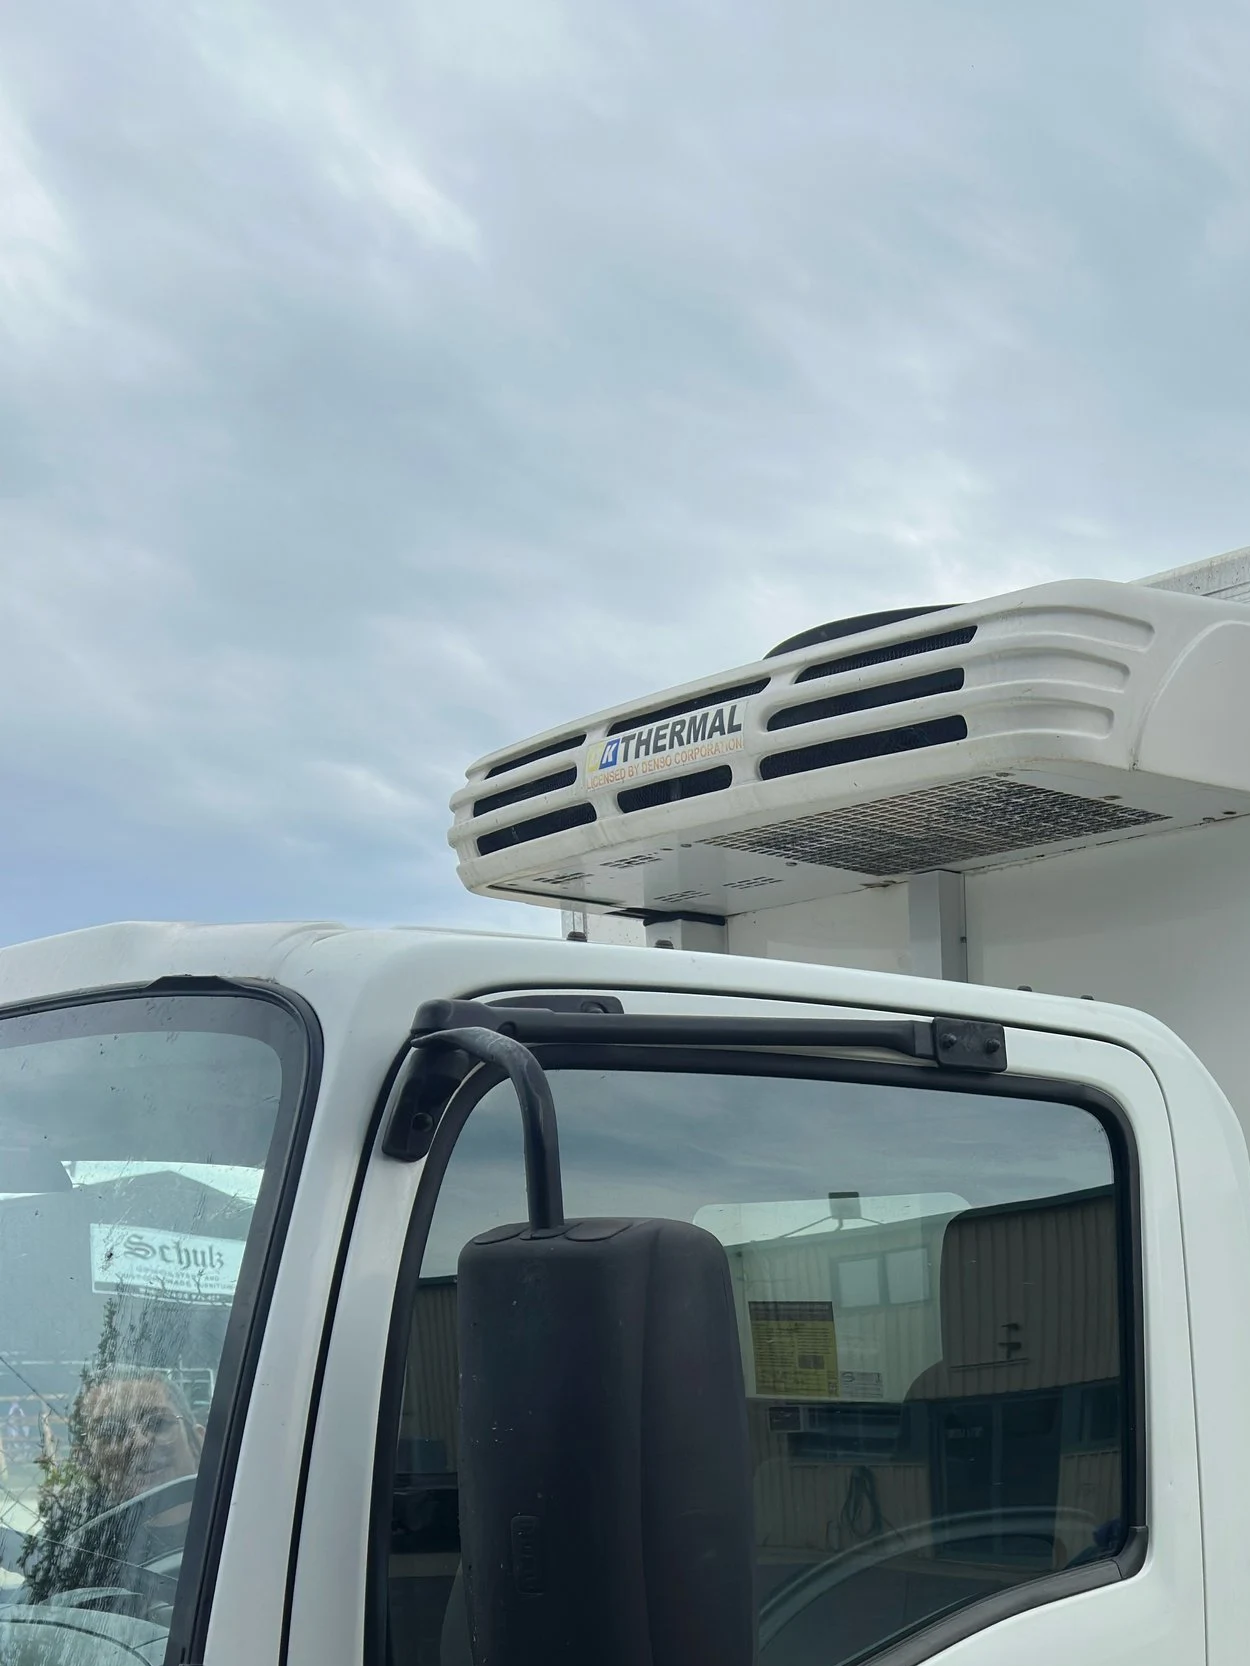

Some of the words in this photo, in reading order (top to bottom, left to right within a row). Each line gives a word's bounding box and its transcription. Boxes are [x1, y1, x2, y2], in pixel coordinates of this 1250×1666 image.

[621, 705, 742, 763] THERMAL
[587, 768, 626, 790] LICENSED
[628, 764, 640, 778] BY
[642, 755, 672, 774] DENSO
[674, 738, 743, 765] CORPORATION
[123, 1233, 225, 1270] Schulz
